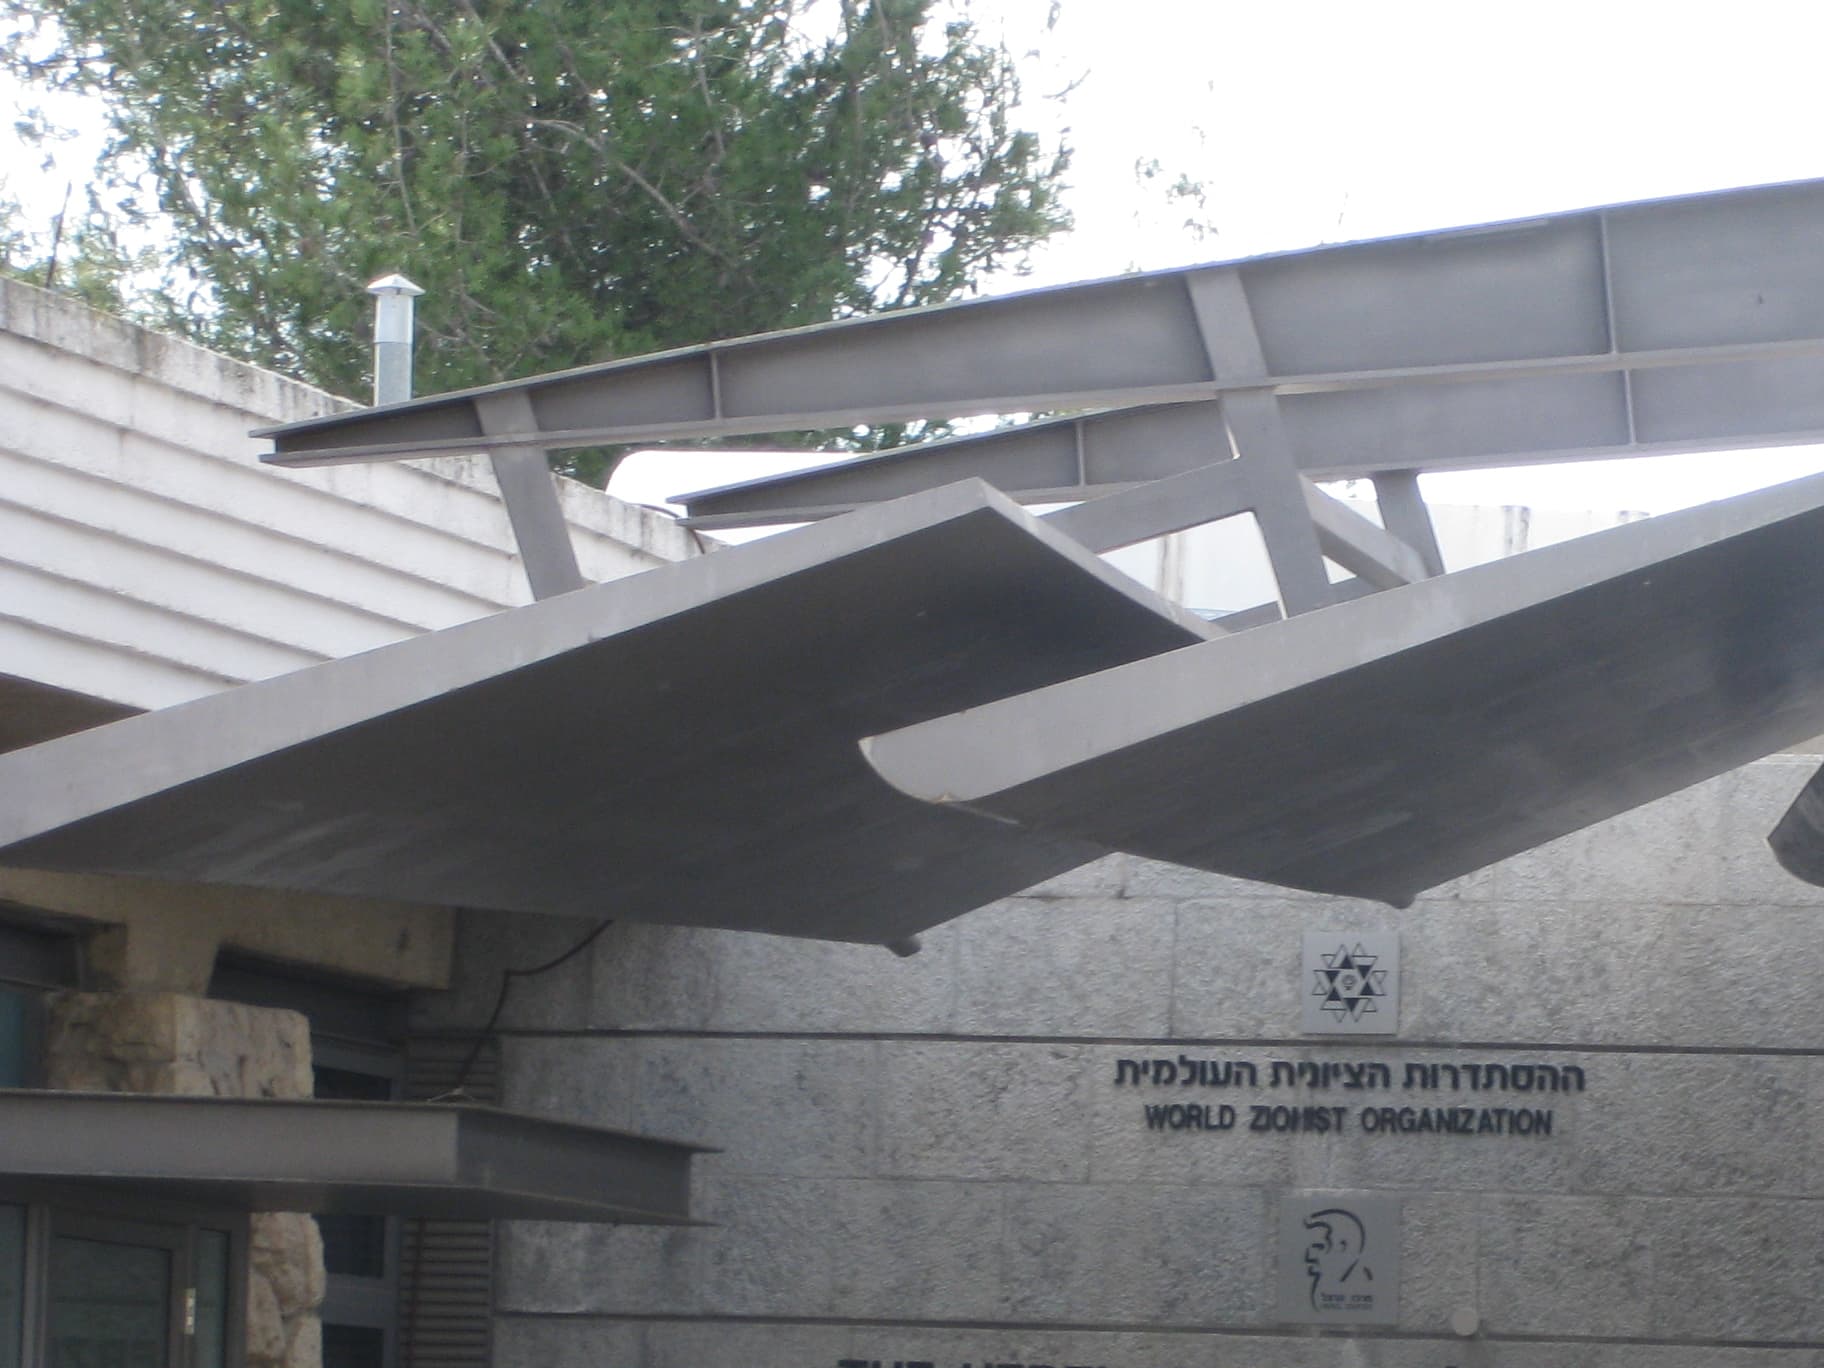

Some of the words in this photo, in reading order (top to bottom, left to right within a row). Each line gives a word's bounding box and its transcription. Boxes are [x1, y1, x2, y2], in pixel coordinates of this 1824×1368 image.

[1114, 1055, 1258, 1087] העולמית
[1269, 1060, 1391, 1089] הציונית
[1403, 1062, 1586, 1092] ההסתדרות
[1144, 1104, 1236, 1131] WORLD
[1250, 1105, 1347, 1132] ZIONIST
[1361, 1107, 1554, 1136] ORGANIZATION
